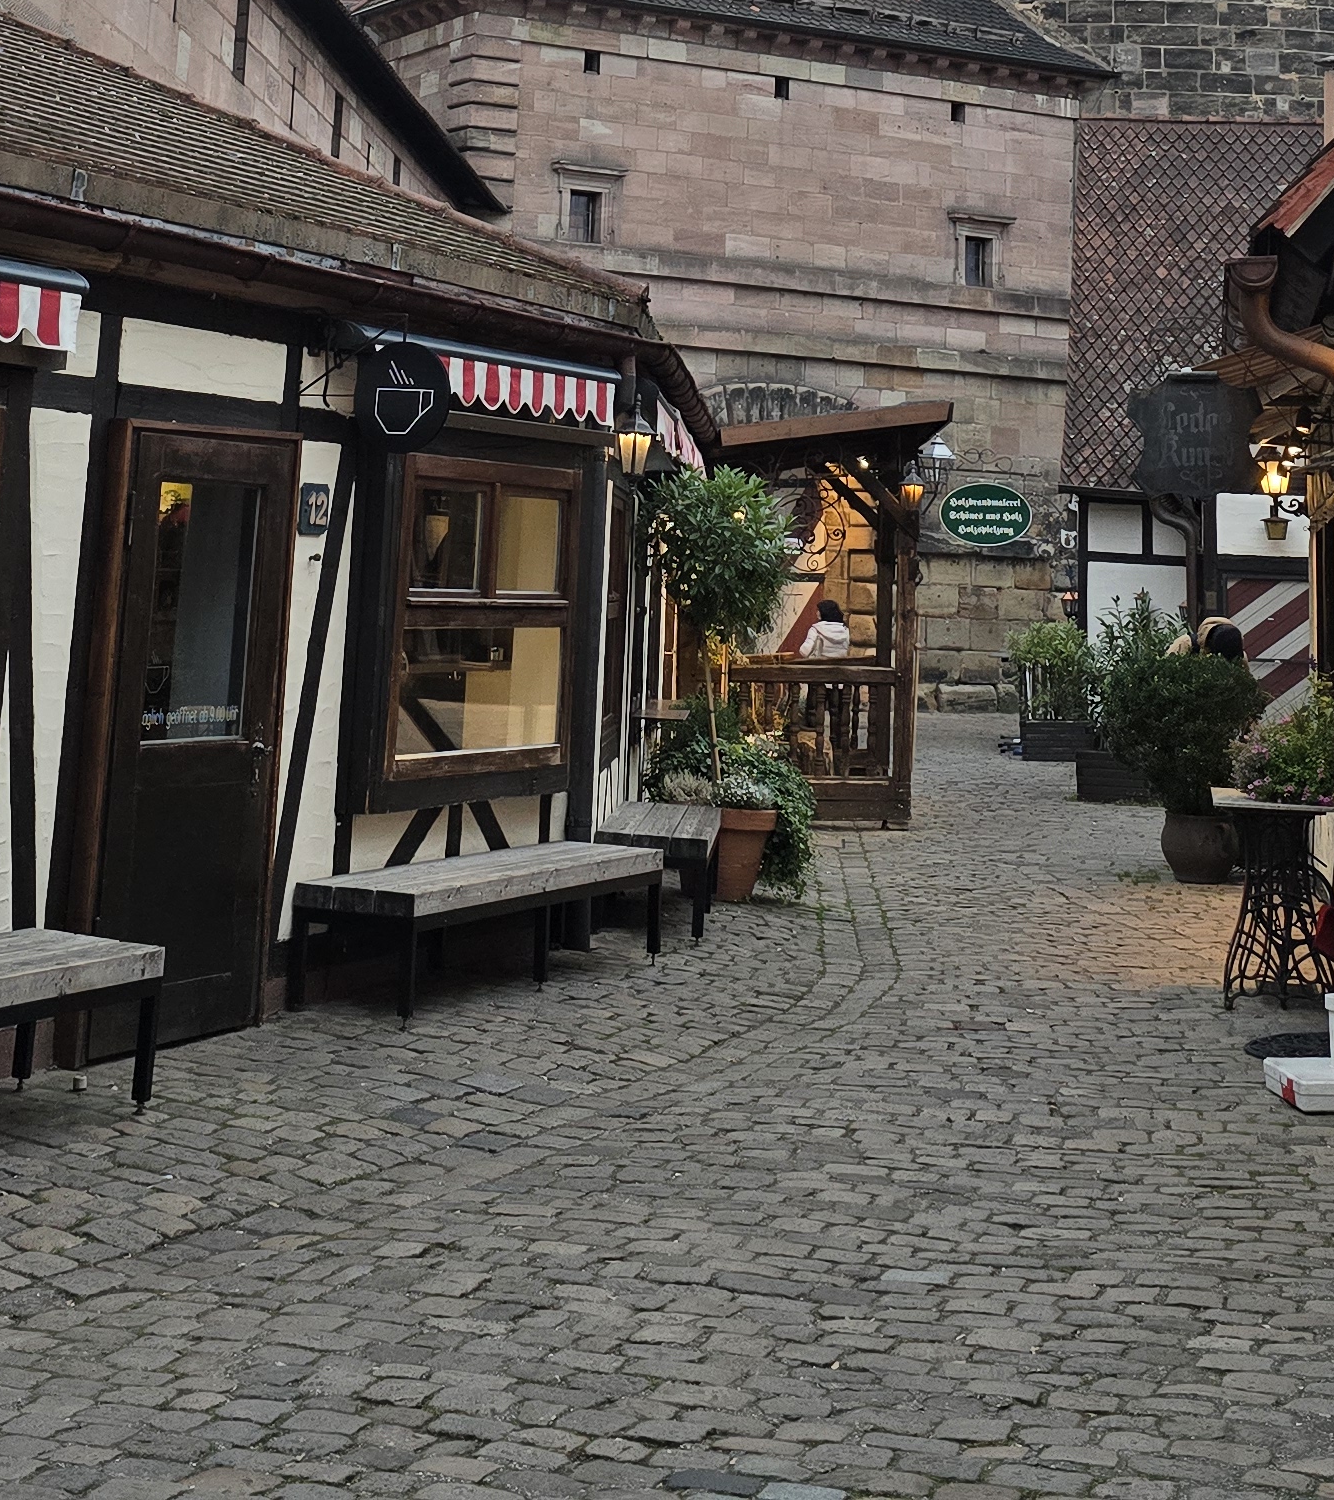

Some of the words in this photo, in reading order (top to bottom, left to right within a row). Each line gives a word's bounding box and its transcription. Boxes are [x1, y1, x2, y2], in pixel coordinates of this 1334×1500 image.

[307, 490, 328, 526] 12
[949, 510, 984, 520] Schönes
[1002, 511, 1023, 523] Holz
[166, 705, 198, 730] geöffnet
[199, 706, 208, 723] ab
[209, 705, 226, 723] 9.00
[226, 704, 239, 721] Uhr
